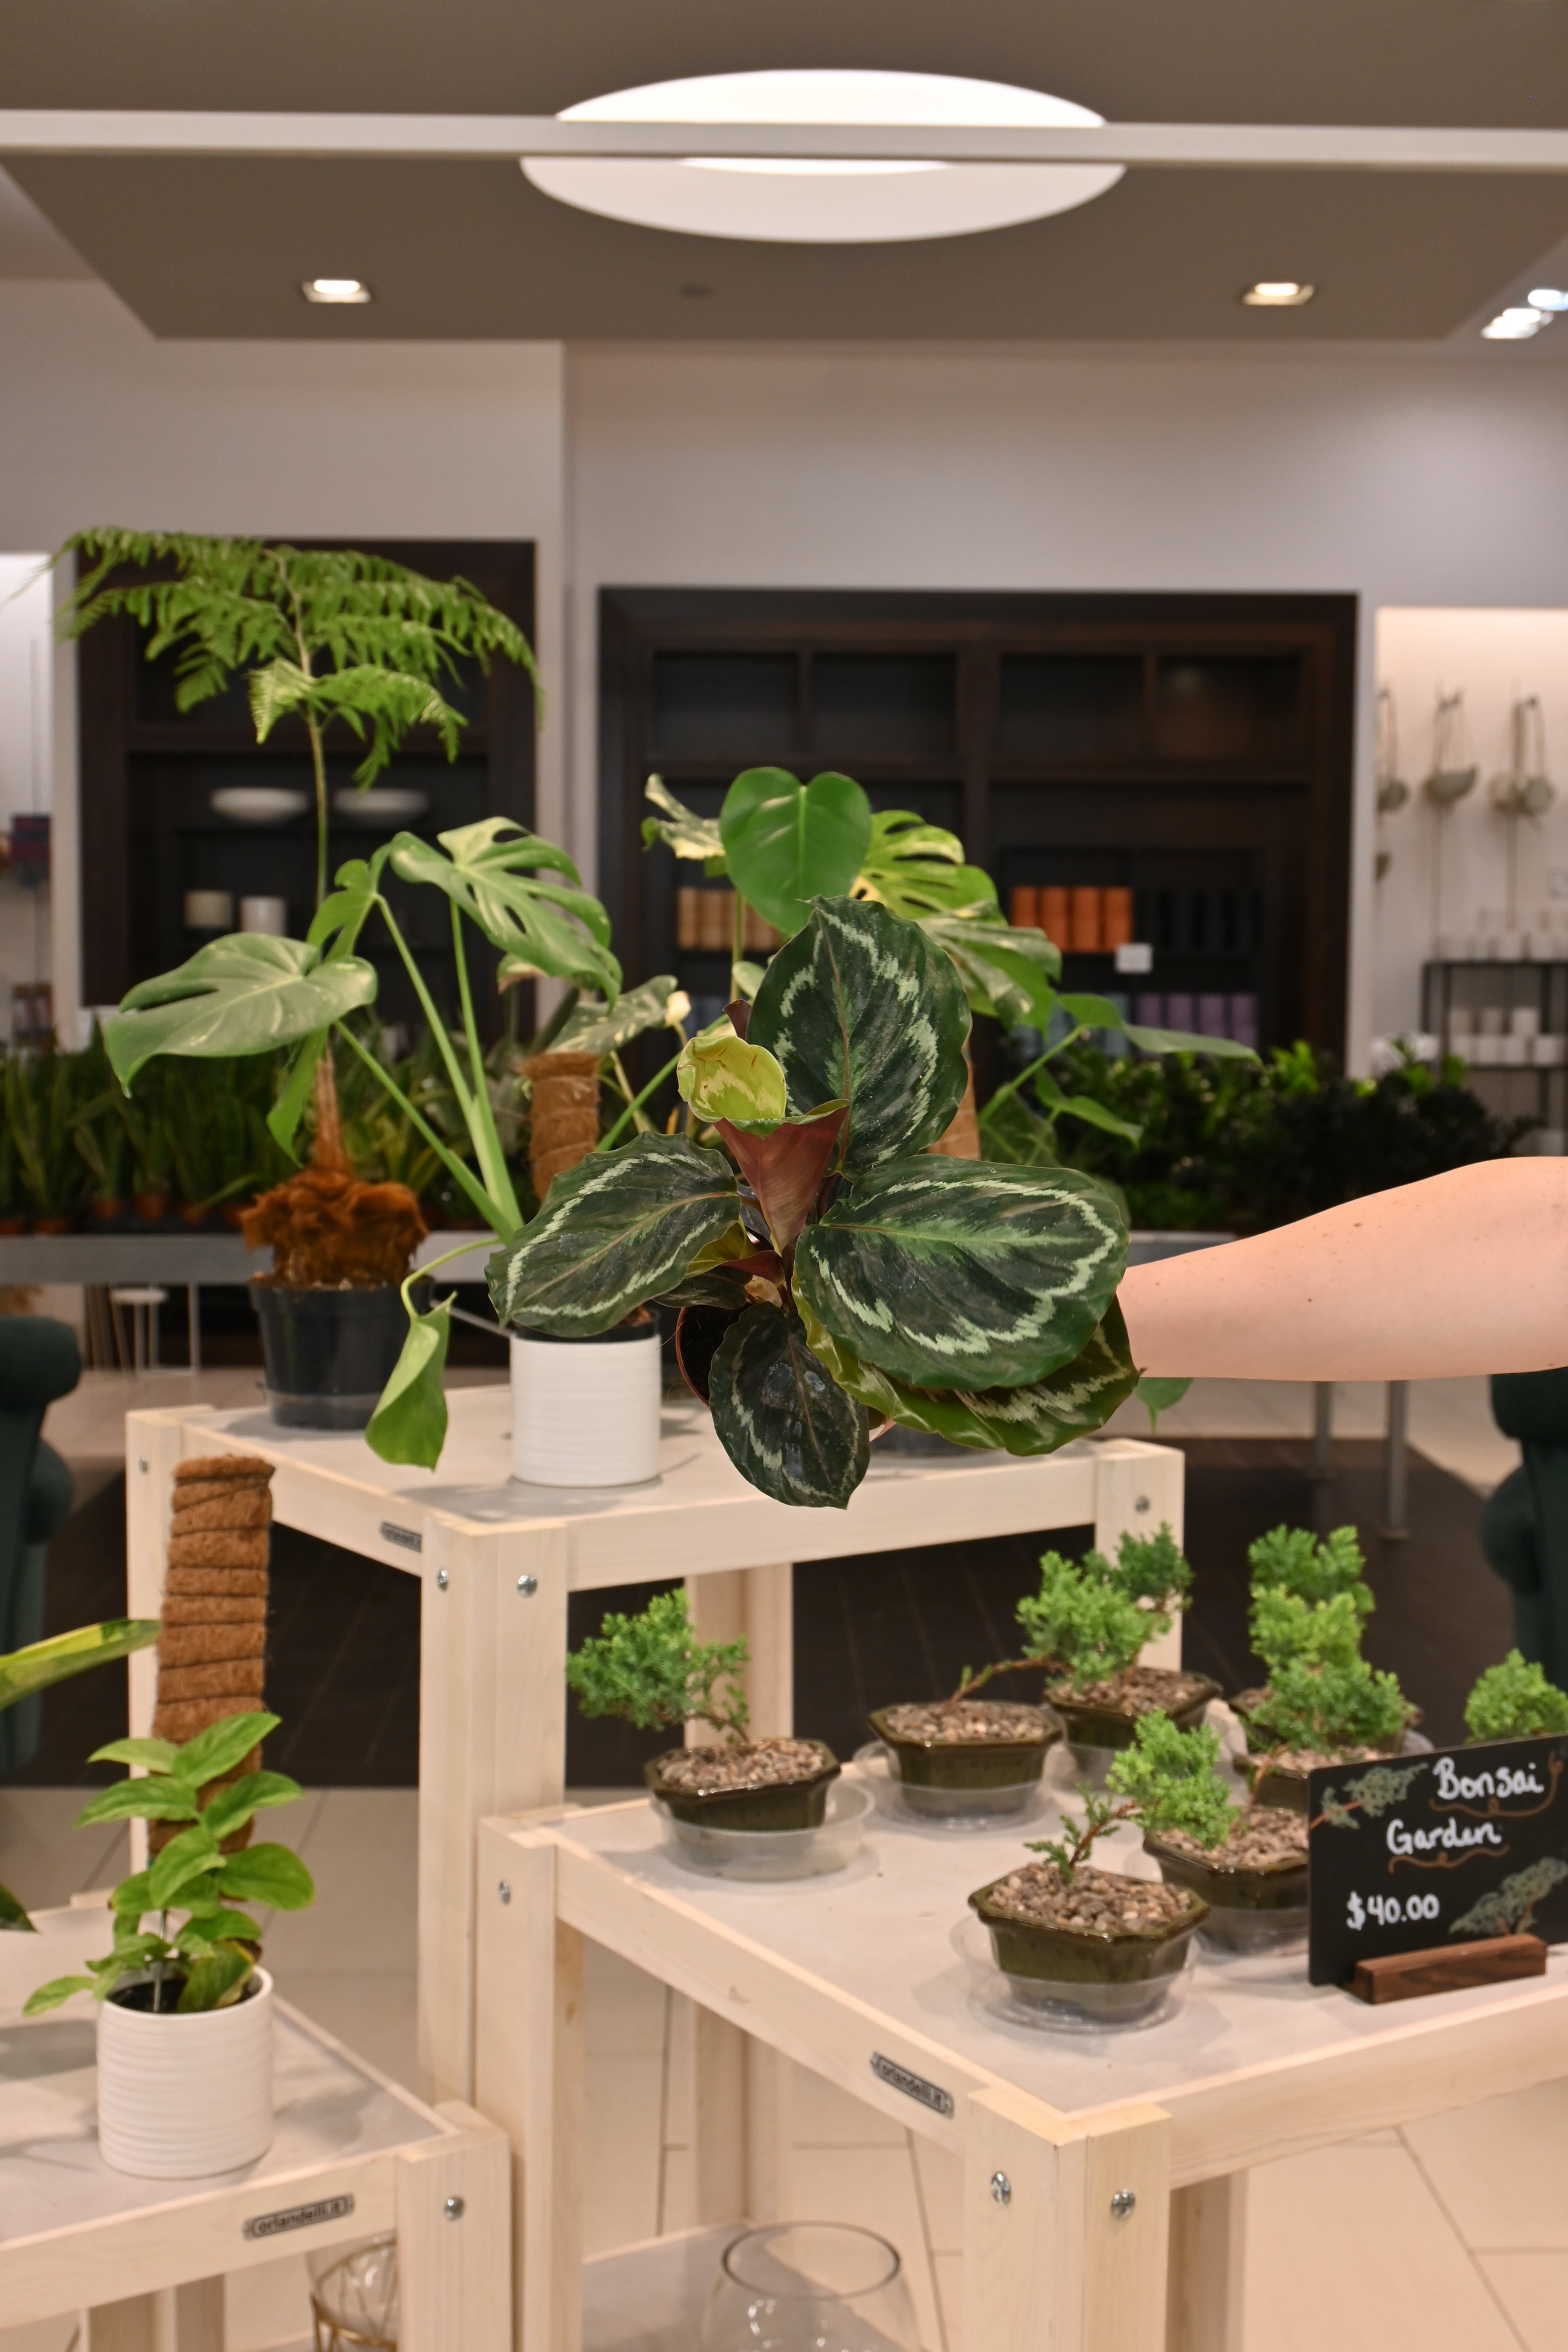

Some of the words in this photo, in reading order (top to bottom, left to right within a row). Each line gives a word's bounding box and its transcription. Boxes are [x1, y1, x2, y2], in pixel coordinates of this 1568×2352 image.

[1432, 1756, 1544, 1799] Bonsai
[1386, 1817, 1502, 1854] Garden
[1346, 1891, 1440, 1930] $40.00
